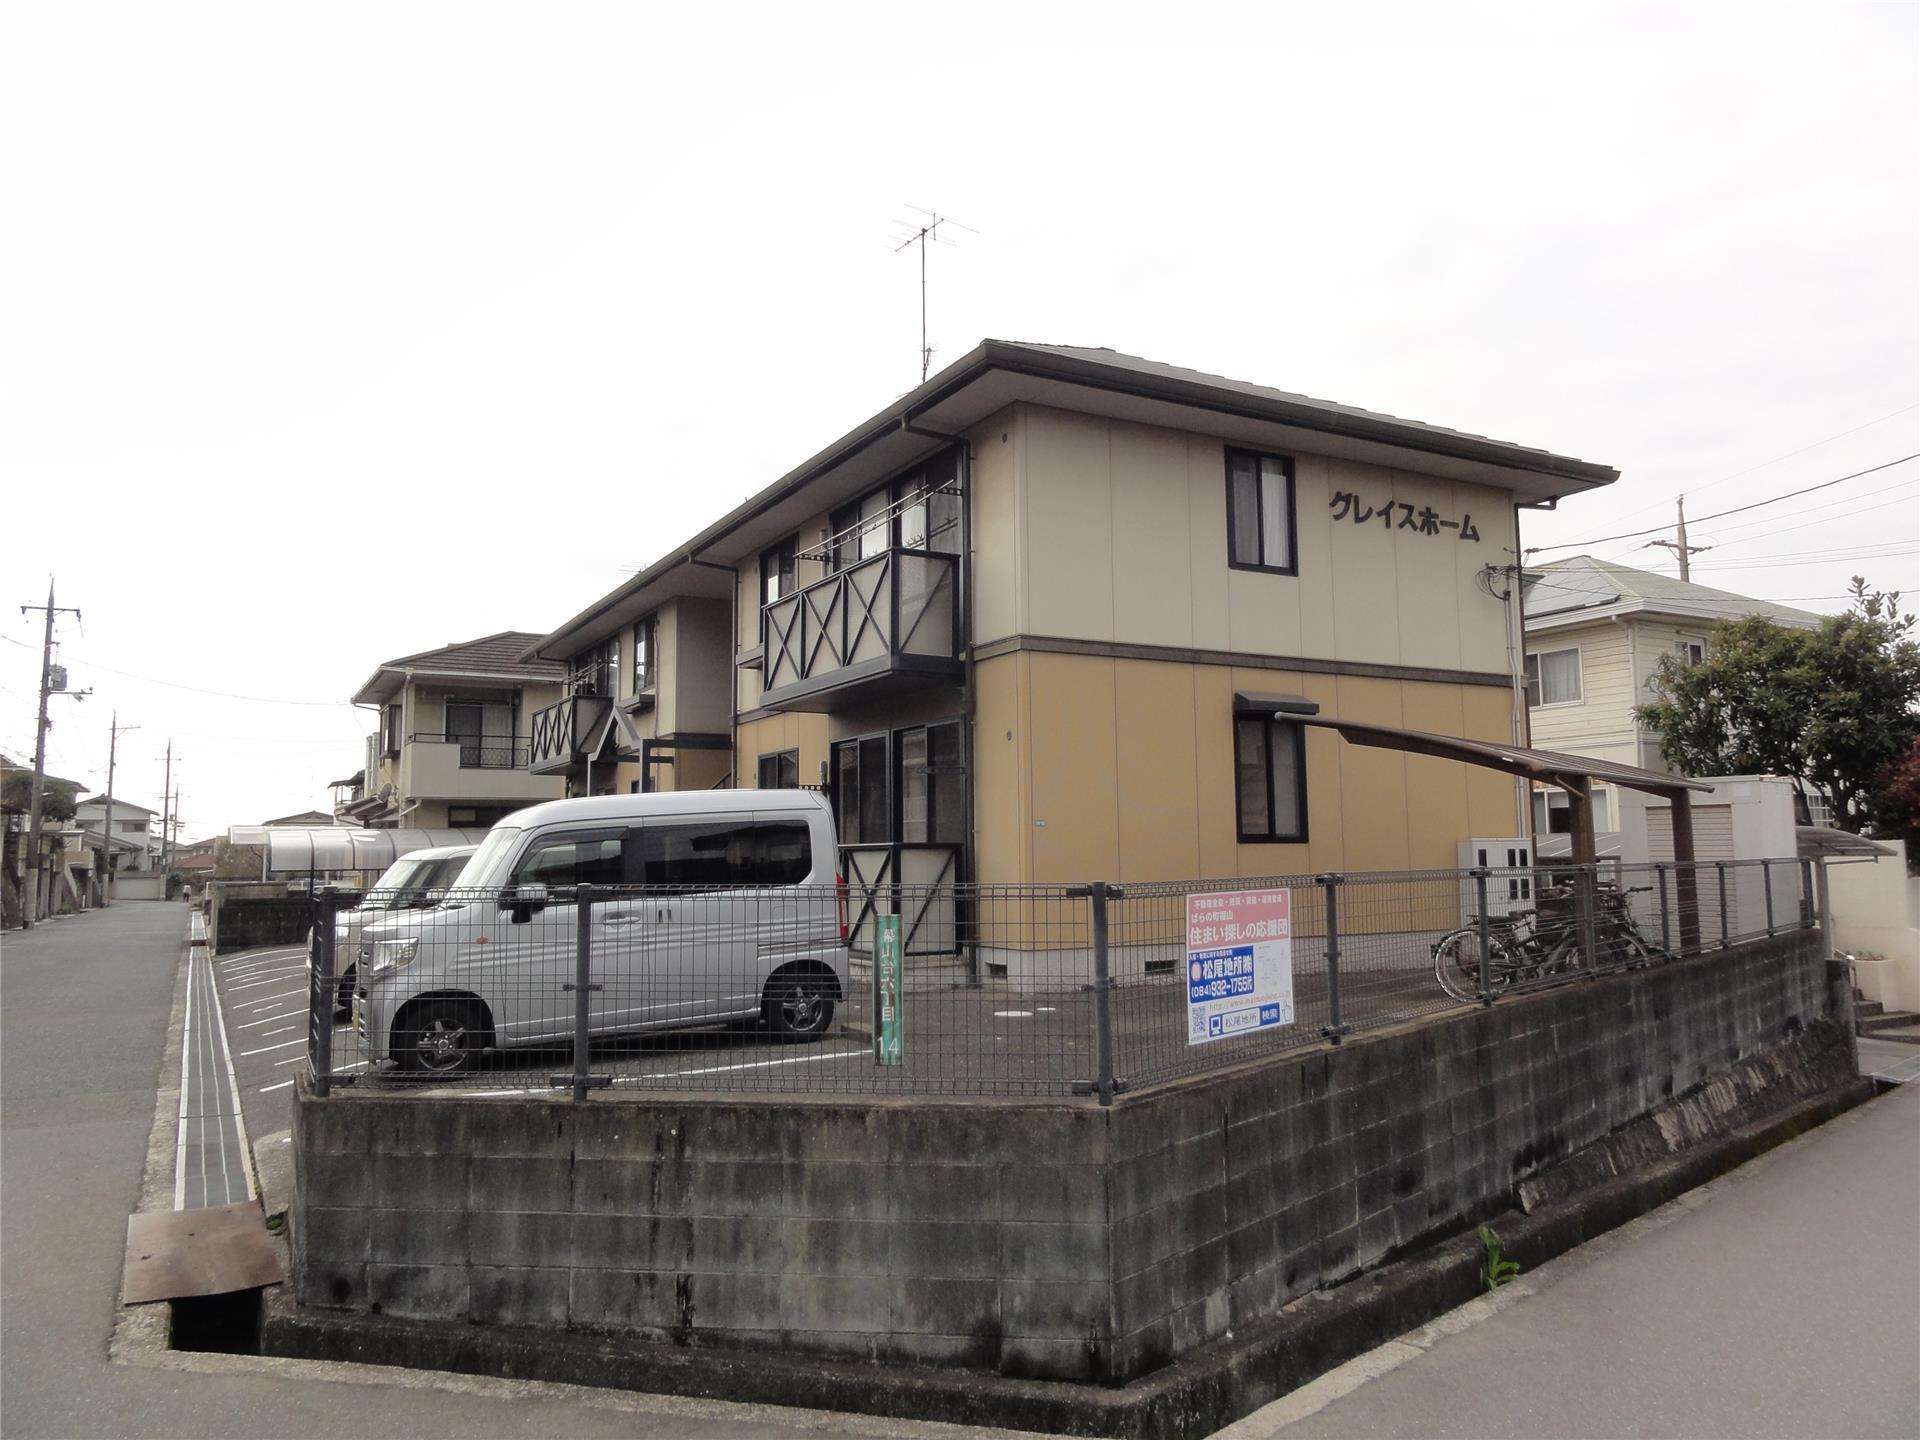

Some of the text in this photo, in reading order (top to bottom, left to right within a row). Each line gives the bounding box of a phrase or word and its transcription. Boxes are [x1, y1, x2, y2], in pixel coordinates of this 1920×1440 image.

[1190, 918, 1288, 945] 住まい探しの応援団
[877, 1036, 899, 1054] 14
